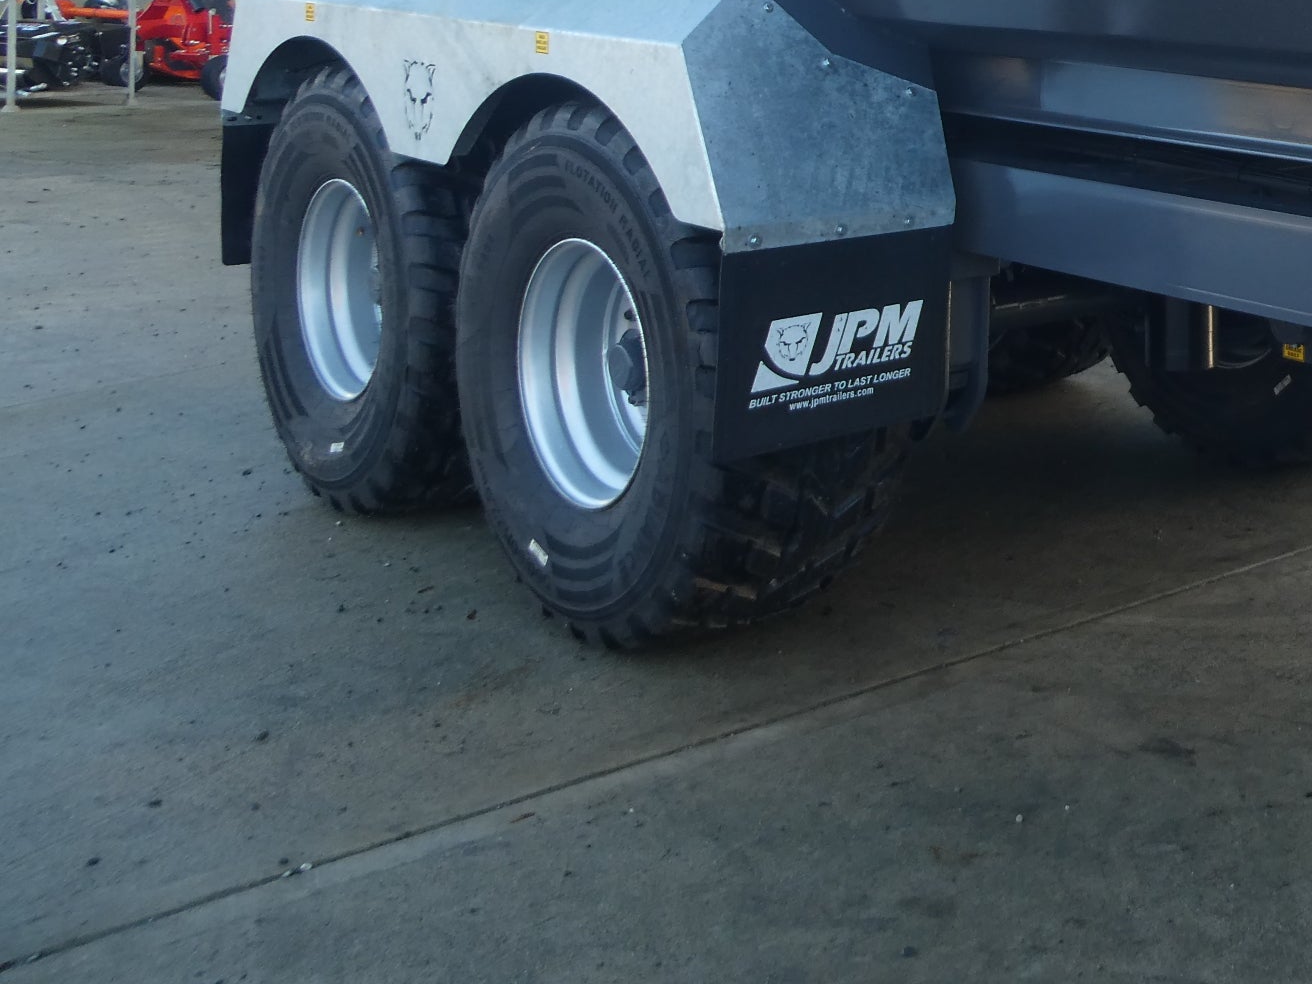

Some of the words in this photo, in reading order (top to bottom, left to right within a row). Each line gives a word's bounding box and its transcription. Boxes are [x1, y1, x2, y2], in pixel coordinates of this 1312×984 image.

[809, 299, 924, 376] JPM
[834, 341, 913, 371] TRAILERS
[749, 394, 778, 409] BUILT
[778, 383, 831, 402] STRONGER
[834, 380, 846, 391] TO
[847, 375, 872, 388] LAST
[873, 368, 911, 383] LONGER
[789, 386, 874, 411] www.jpmtrailers.com
